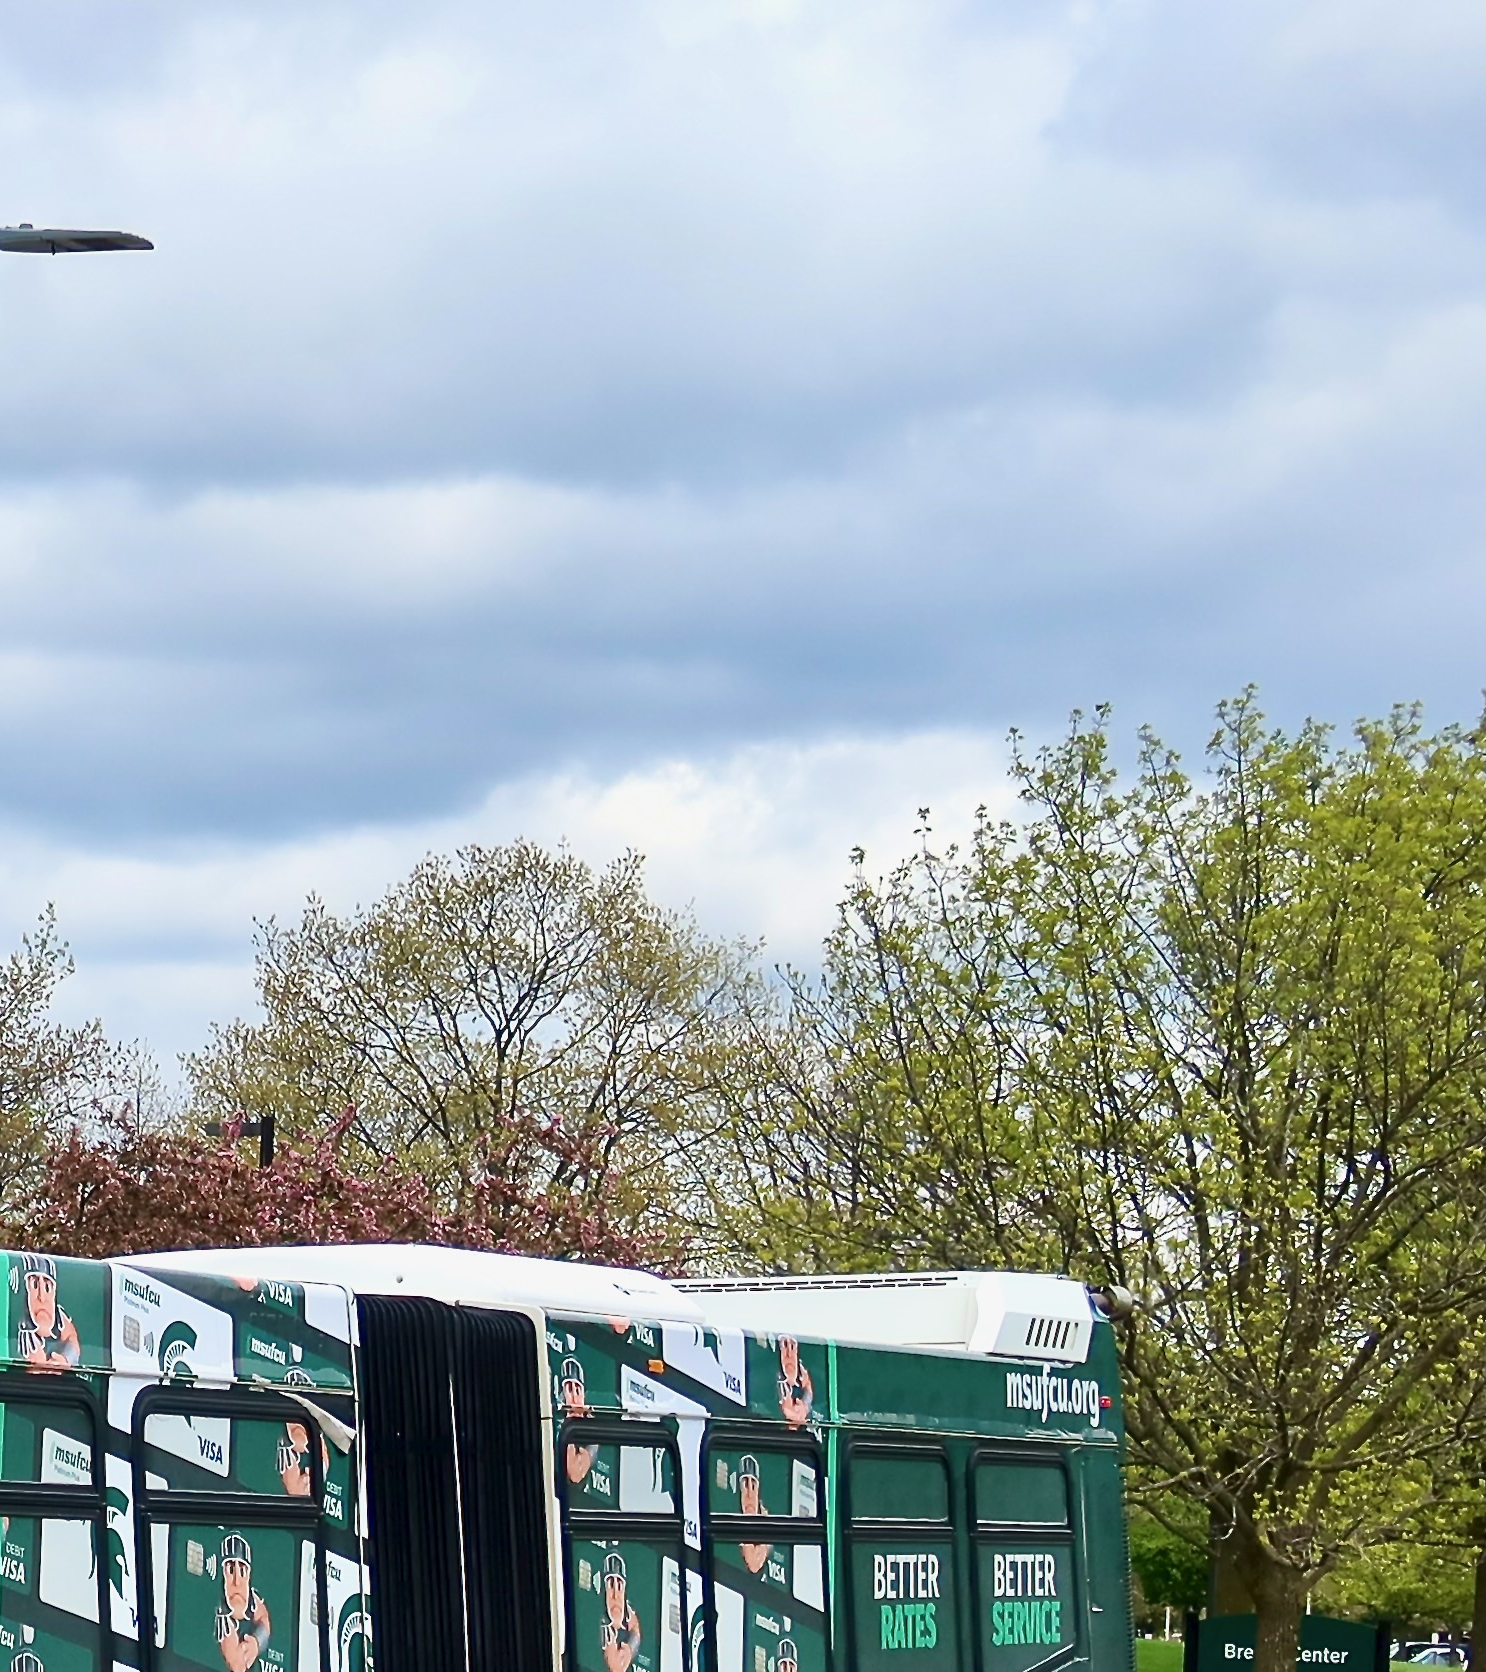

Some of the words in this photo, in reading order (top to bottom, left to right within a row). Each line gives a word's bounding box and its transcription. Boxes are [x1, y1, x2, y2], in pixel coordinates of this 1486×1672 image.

[265, 1280, 293, 1308] VISA
[1006, 1362, 1100, 1428] msufcu.org
[197, 1435, 223, 1465] VISA
[873, 1554, 940, 1599] BETTER
[993, 1554, 1056, 1597] BETTER
[881, 1602, 937, 1649] RATES
[992, 1600, 1061, 1646] SERVICE
